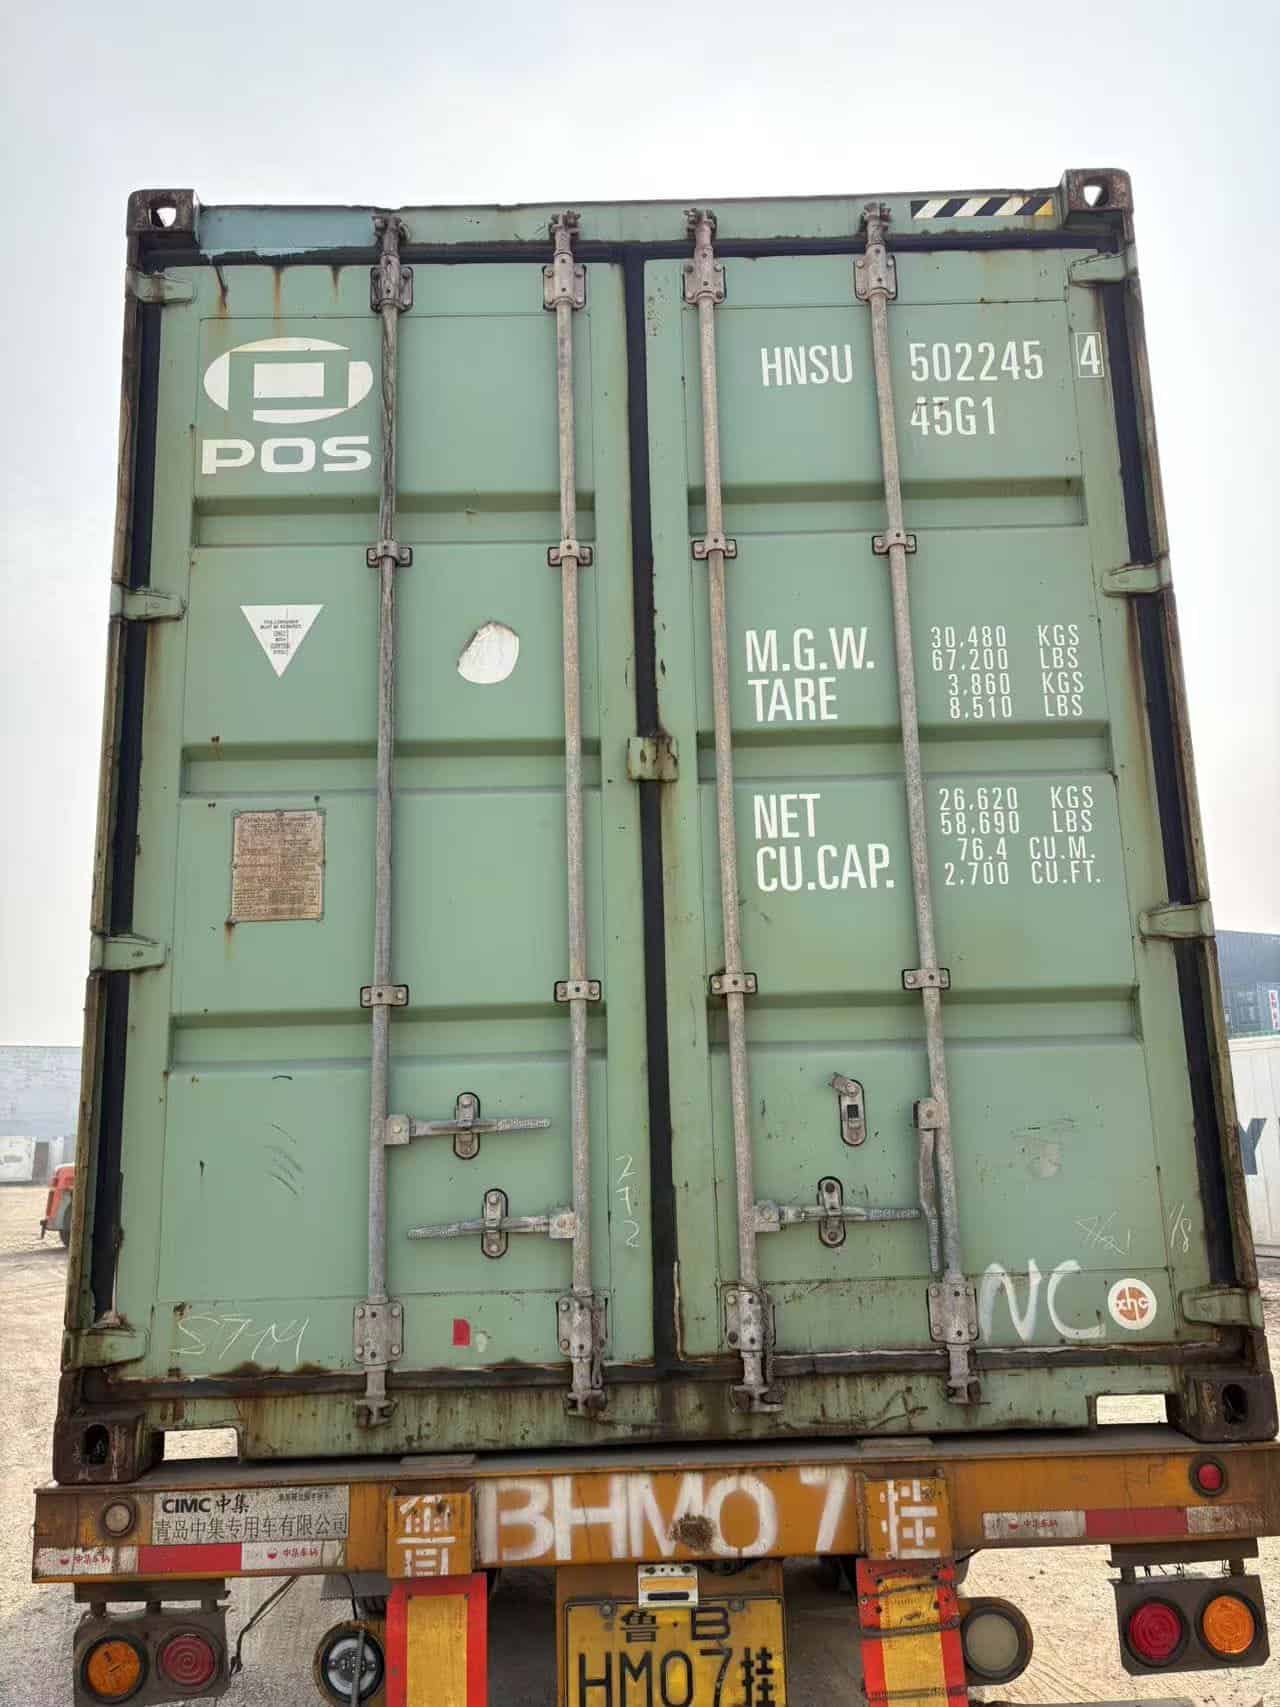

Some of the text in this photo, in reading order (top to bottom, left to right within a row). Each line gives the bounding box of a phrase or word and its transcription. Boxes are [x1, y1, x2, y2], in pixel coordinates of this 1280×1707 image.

[761, 335, 1102, 386] HNSU 502245 4
[910, 396, 997, 436] 45G1
[201, 436, 372, 474] POS
[745, 627, 875, 673] M.G.W.
[1037, 624, 1080, 647] KGS
[1039, 647, 1079, 669] LBS
[748, 677, 839, 722] TARE
[1042, 672, 1085, 694] KGS
[1044, 694, 1084, 718] LBS
[753, 793, 821, 840] NET
[1050, 785, 1095, 810] KGS
[1052, 809, 1093, 833] LBS
[756, 836, 1096, 893] CU.CAP. 76.4 CU.M.
[1030, 860, 1102, 884] CU.FT.
[162, 1494, 250, 1514] CIMC 中集
[154, 1511, 348, 1543] 青岛中集专用车有限公司
[691, 1606, 731, 1641] B
